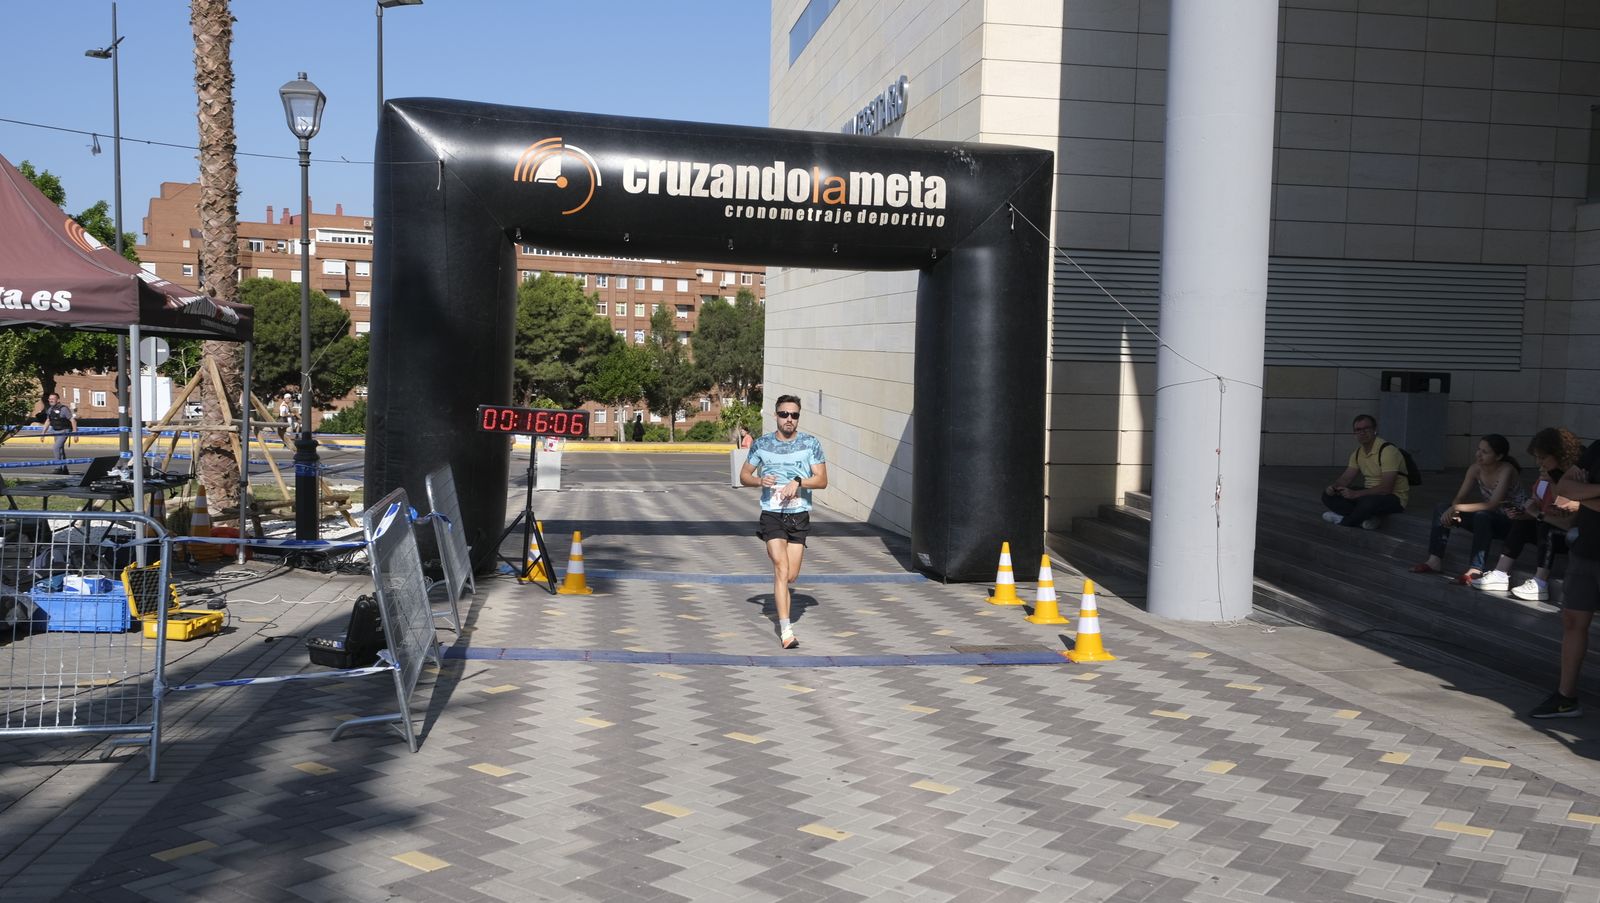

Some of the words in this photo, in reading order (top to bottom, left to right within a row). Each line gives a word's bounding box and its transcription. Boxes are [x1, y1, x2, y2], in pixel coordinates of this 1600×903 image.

[622, 158, 947, 210] cruzandolameta
[724, 204, 852, 224] cronometraje
[856, 209, 946, 228] deportivo
[483, 408, 583, 435] 00:16:06
